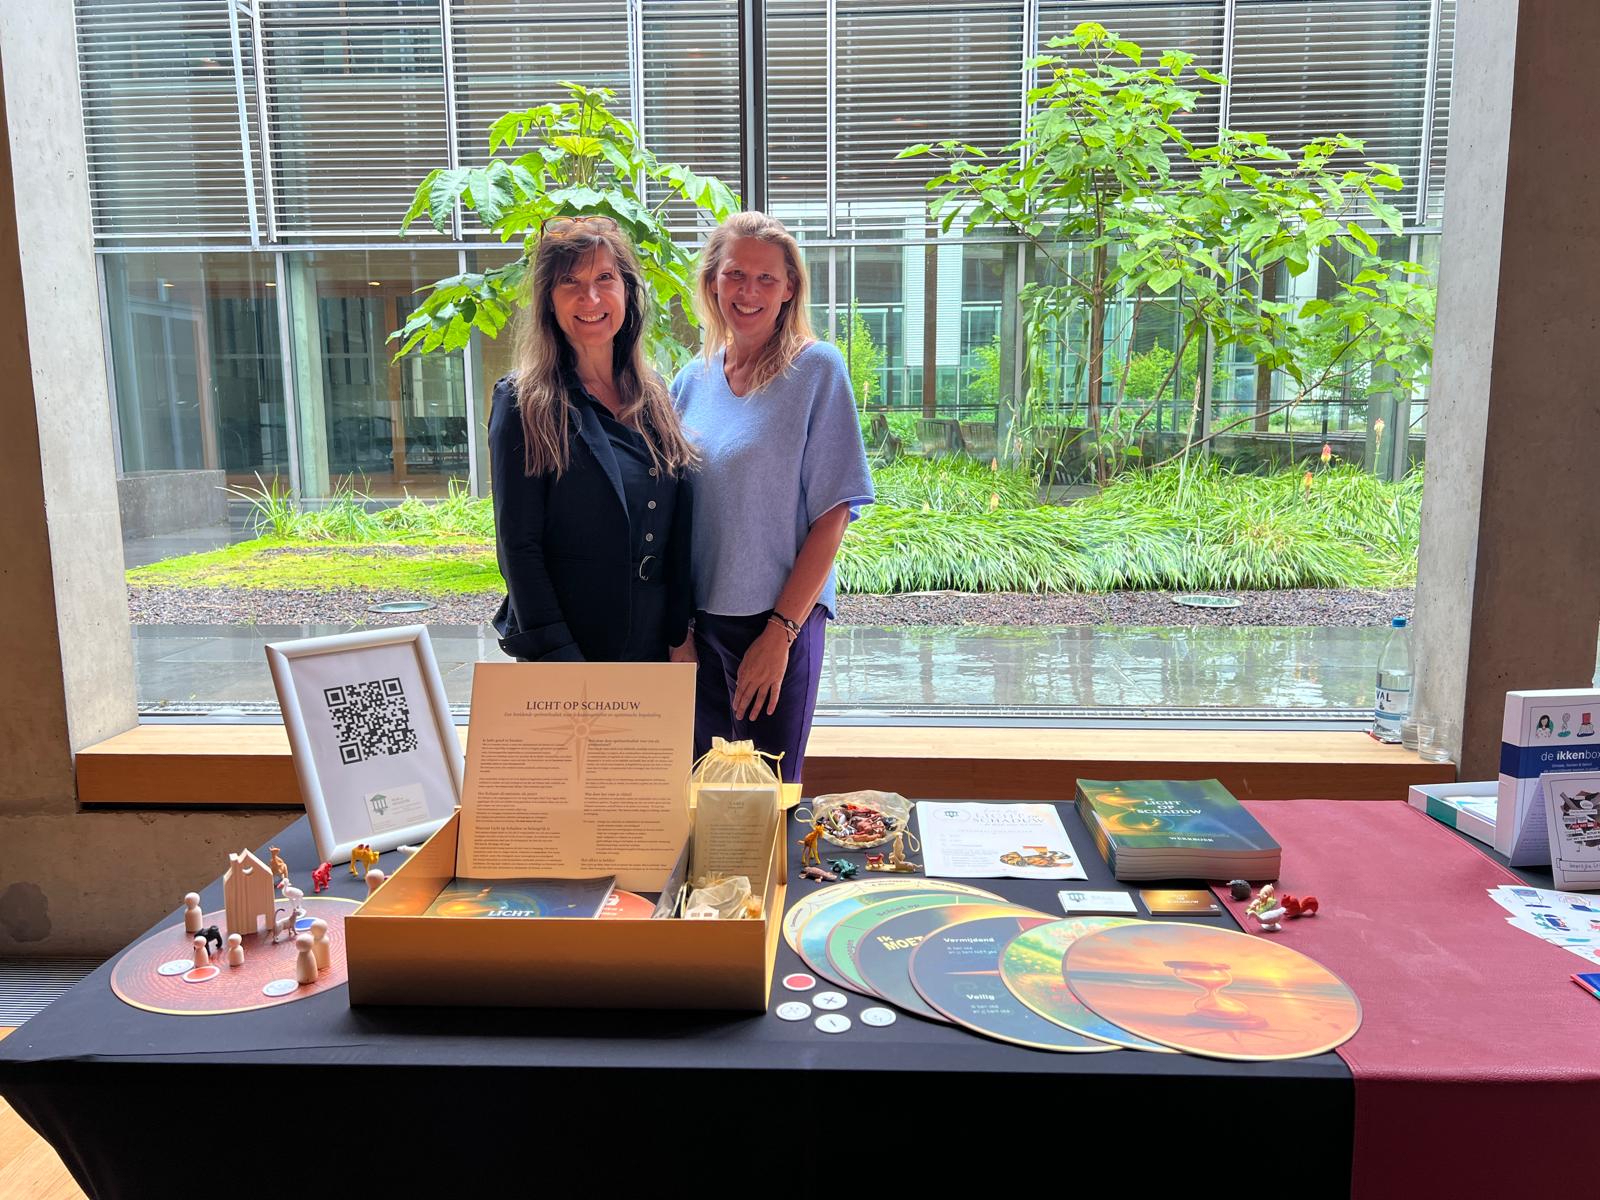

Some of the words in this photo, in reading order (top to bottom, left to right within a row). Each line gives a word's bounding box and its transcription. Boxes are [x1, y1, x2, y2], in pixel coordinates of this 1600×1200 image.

[526, 701, 561, 710] LICHT
[563, 701, 579, 710] OP
[581, 701, 640, 710] SCHADUW
[1541, 751, 1554, 761] de
[882, 935, 924, 950] MOET
